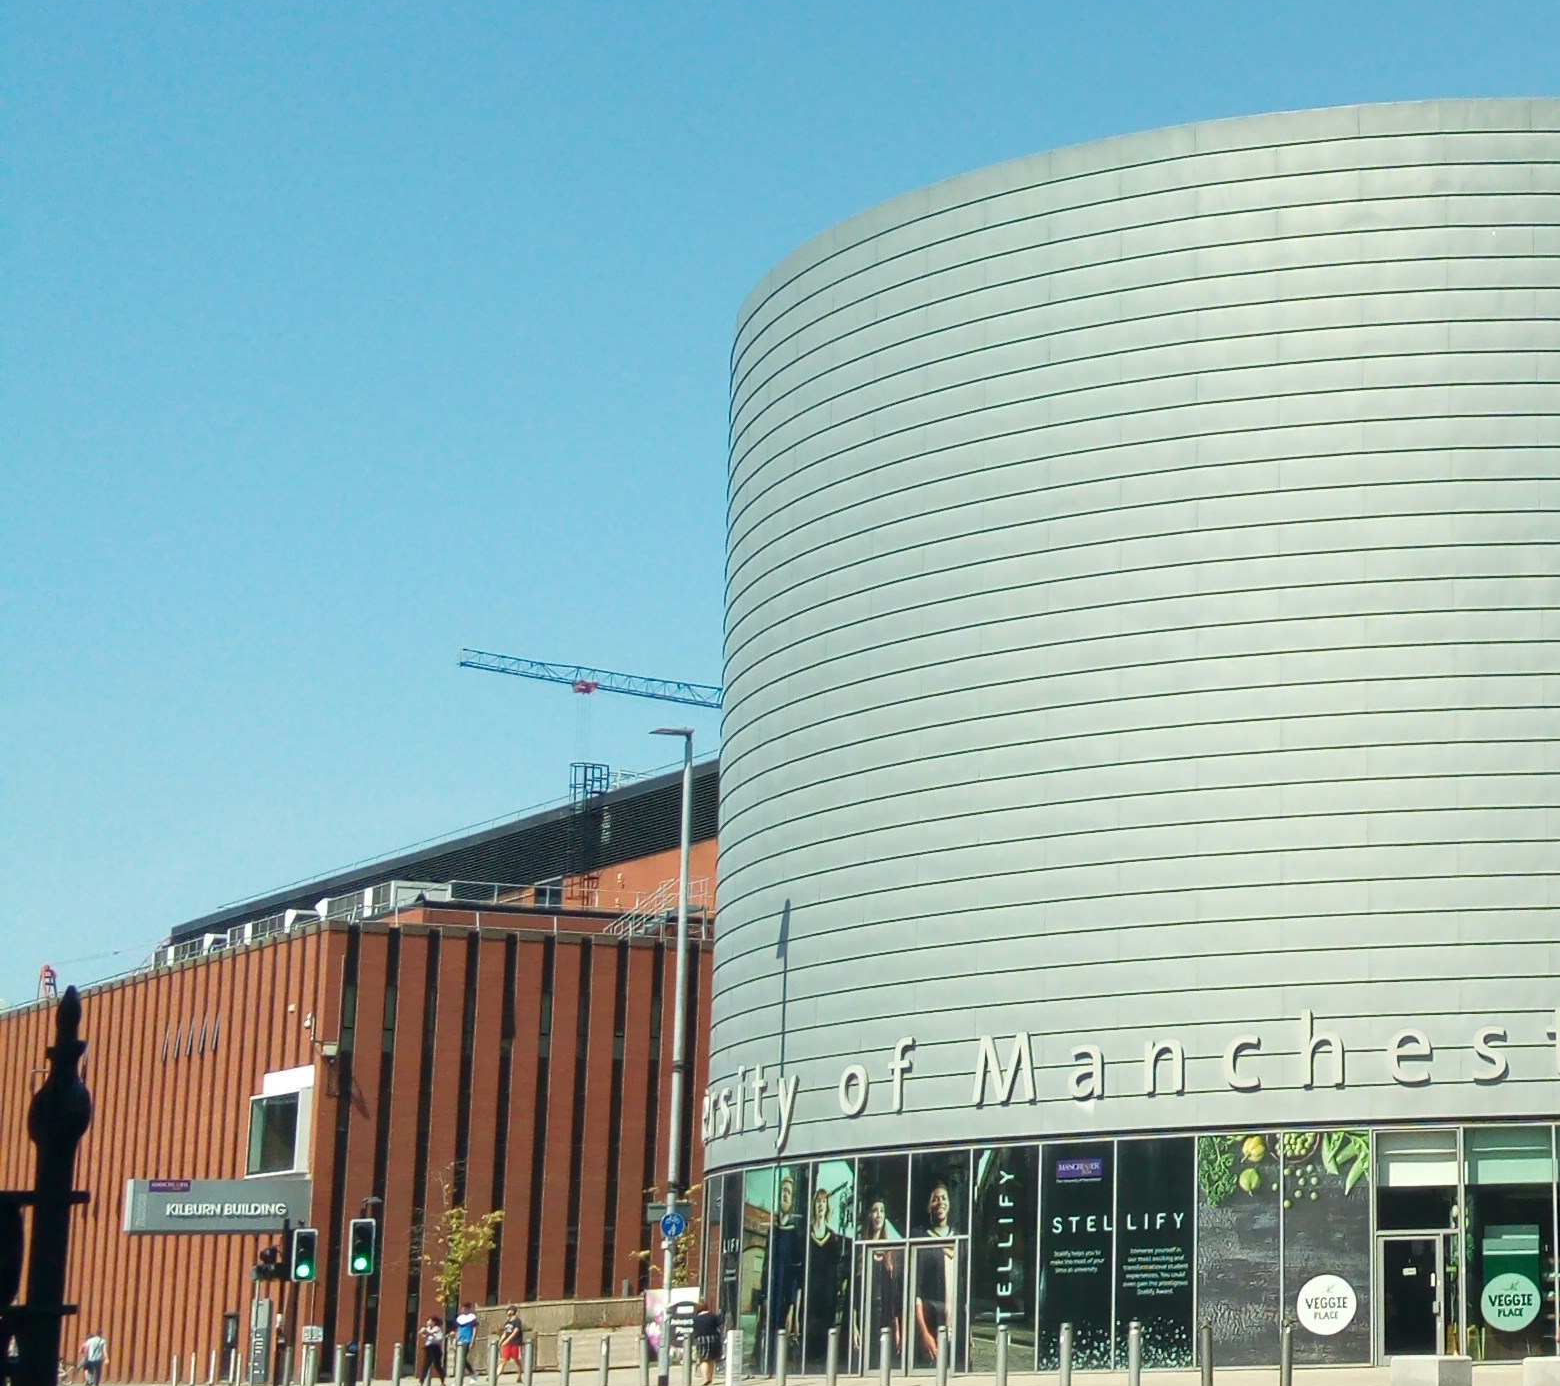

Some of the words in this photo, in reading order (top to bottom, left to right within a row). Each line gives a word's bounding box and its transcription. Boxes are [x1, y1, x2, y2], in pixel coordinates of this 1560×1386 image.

[838, 1036, 915, 1116] of
[1058, 1162, 1100, 1171] MANCHER
[166, 1203, 221, 1216] KILBURN
[223, 1203, 287, 1216] BUILDING
[996, 1170, 1014, 1346] TELLIFY
[1305, 1296, 1348, 1309] VEGGIE
[1487, 1293, 1533, 1307] VEGGIE
[1313, 1311, 1339, 1320] PLACE
[1497, 1308, 1523, 1318] PLACE
